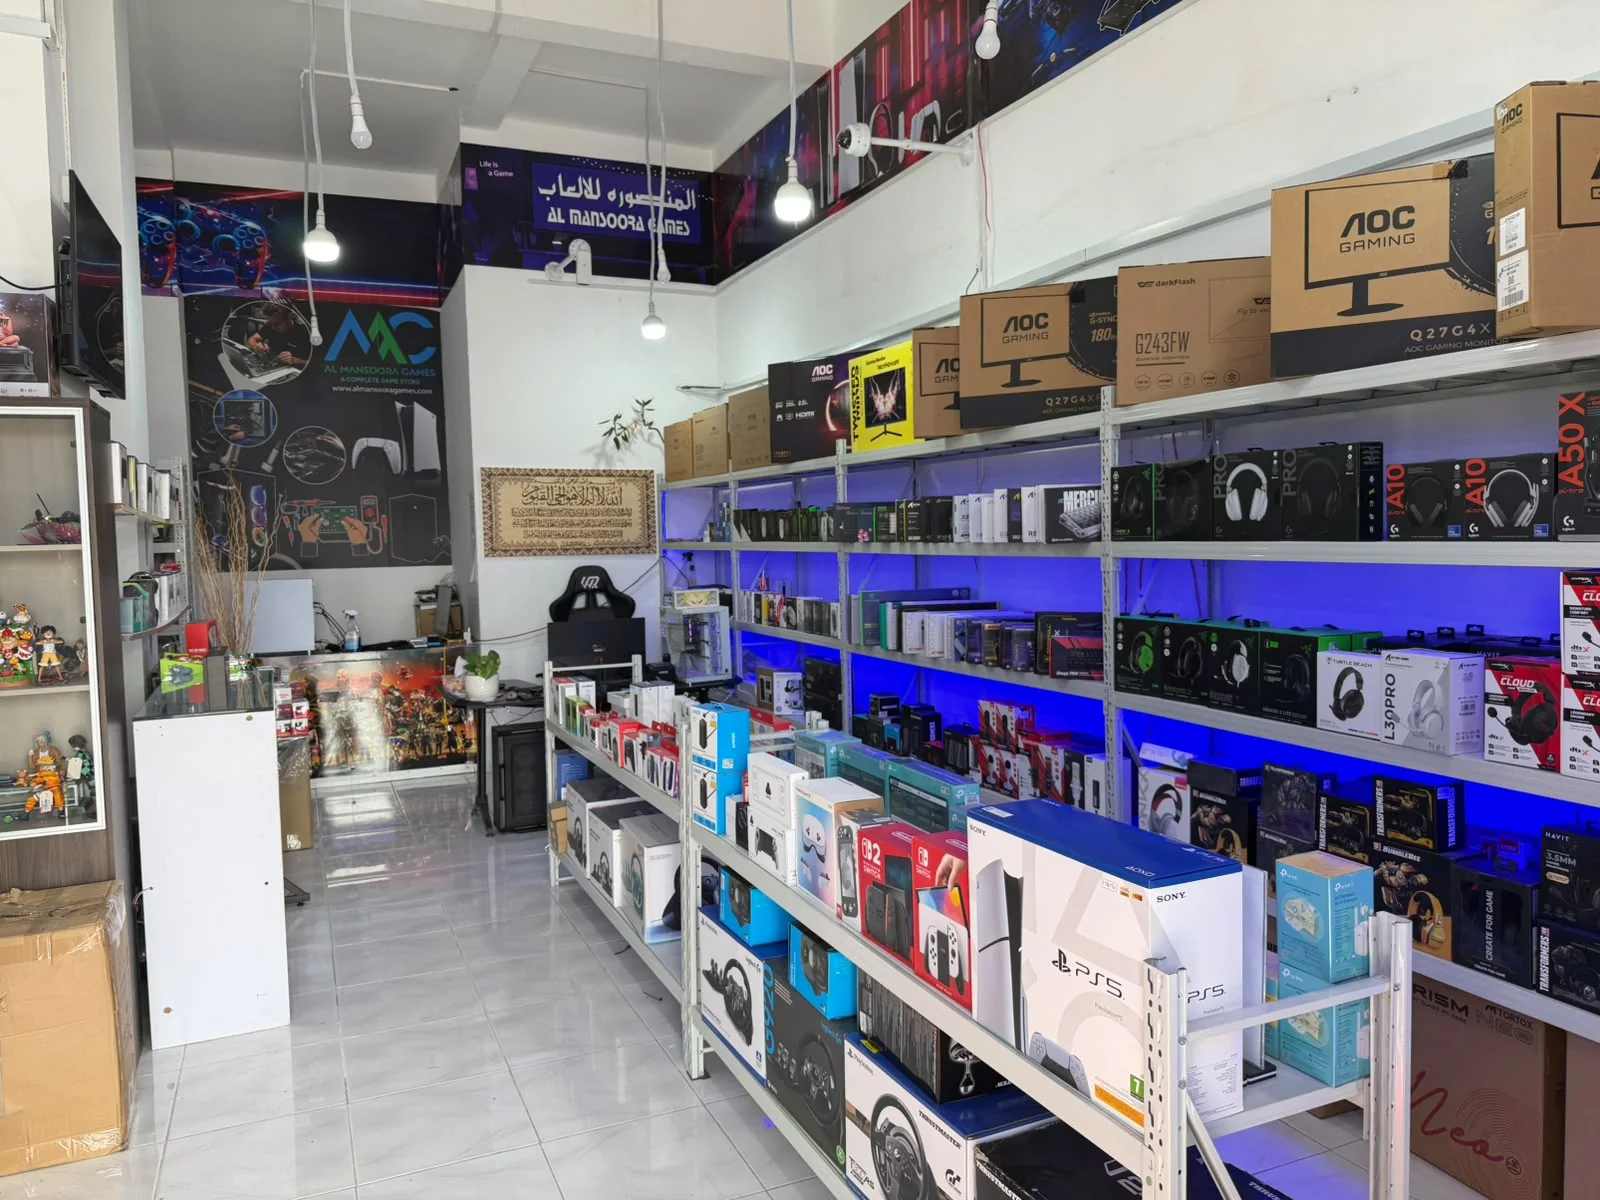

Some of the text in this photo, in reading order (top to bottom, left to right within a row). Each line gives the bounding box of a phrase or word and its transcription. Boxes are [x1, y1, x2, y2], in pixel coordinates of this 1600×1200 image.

[547, 207, 565, 224] AL
[569, 208, 645, 232] MANSOORA
[1340, 205, 1415, 238] AOC
[1339, 232, 1416, 253] GAMING
[1003, 313, 1049, 333] AOC
[1002, 332, 1049, 344] GAMING
[1136, 331, 1190, 355] G243FW
[1425, 343, 1463, 352] GAMING
[324, 365, 436, 377] AL MANSOORA GAMES
[811, 364, 834, 376] AOC
[936, 358, 960, 373] AO
[934, 375, 960, 384] GAM
[332, 385, 432, 395] www.almansooragames.com
[1558, 391, 1586, 488] A50 X
[1214, 456, 1227, 498] PRO
[1283, 450, 1297, 497] PRO
[1465, 458, 1486, 507] A10
[1387, 464, 1405, 509] A10
[1500, 677, 1535, 688] CLOUD
[1384, 673, 1396, 741] L30PRO
[1376, 787, 1384, 836] TRANSFORMERS
[970, 824, 986, 836] SONY
[1319, 803, 1327, 850] TRANSFORMERS
[1545, 831, 1571, 842] HAVIT
[872, 843, 881, 866] 2
[1383, 846, 1421, 862] BUMBLEBEE
[1546, 853, 1576, 867] 3.5MM
[863, 865, 881, 880] SWITCH
[916, 868, 932, 879] SWITCH
[1157, 892, 1186, 903] SONY
[1486, 890, 1494, 913] GAME
[1540, 935, 1550, 992] TRANSFORMERS
[1075, 961, 1124, 999] PS5
[1187, 984, 1225, 1004] PS5
[1412, 983, 1469, 1018] RISM
[1133, 1078, 1141, 1093] 7
[918, 1110, 961, 1150] THRUSTMASTER
